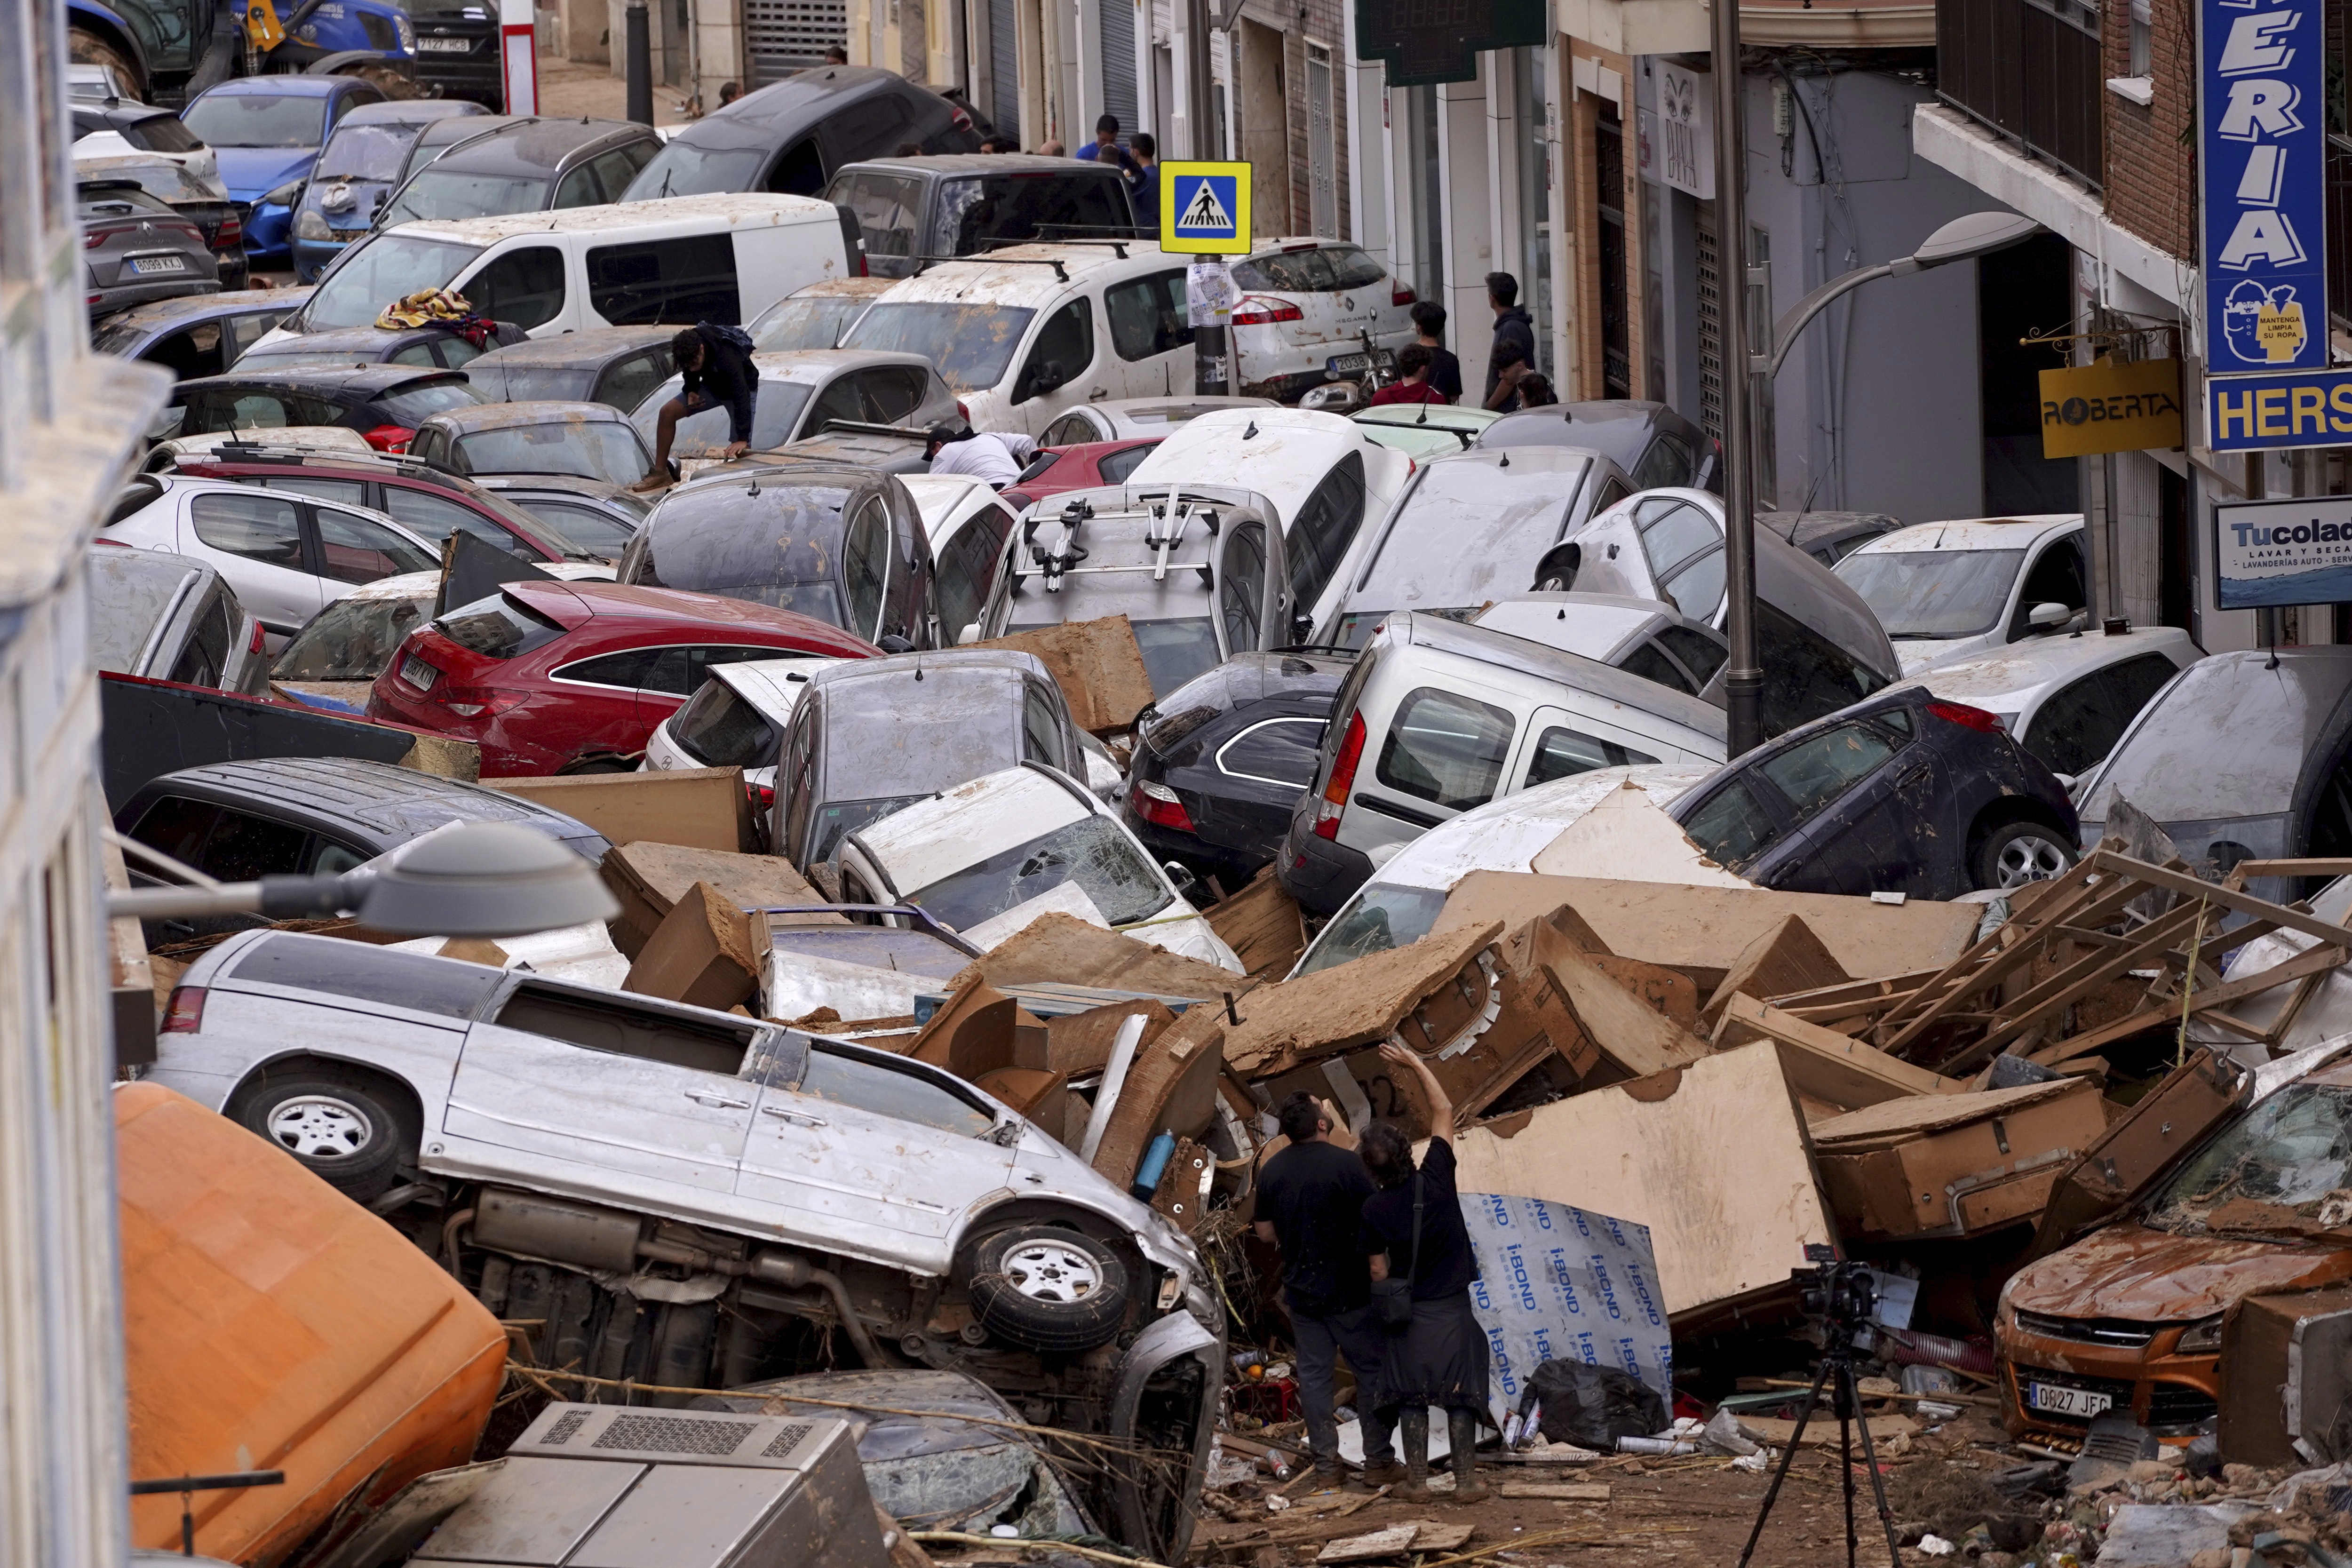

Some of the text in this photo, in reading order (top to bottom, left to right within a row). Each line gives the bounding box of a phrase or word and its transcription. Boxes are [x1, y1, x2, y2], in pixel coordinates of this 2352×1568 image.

[420, 39, 444, 50] 7127
[2217, 0, 2307, 271] ERIA
[1665, 118, 1697, 189] DIVA
[137, 257, 182, 271] 8099 KXJ
[1335, 316, 1368, 324] MEGANE
[1337, 353, 1387, 370] 2038 RP
[2043, 393, 2180, 425] ROBERTA
[2218, 383, 2352, 439] HERS
[2243, 558, 2298, 569] LAVANDERÍAS
[2249, 549, 2292, 558] LAVAR
[406, 658, 422, 677] 3887
[419, 667, 436, 685] KYN
[2040, 1387, 2074, 1412] 0827
